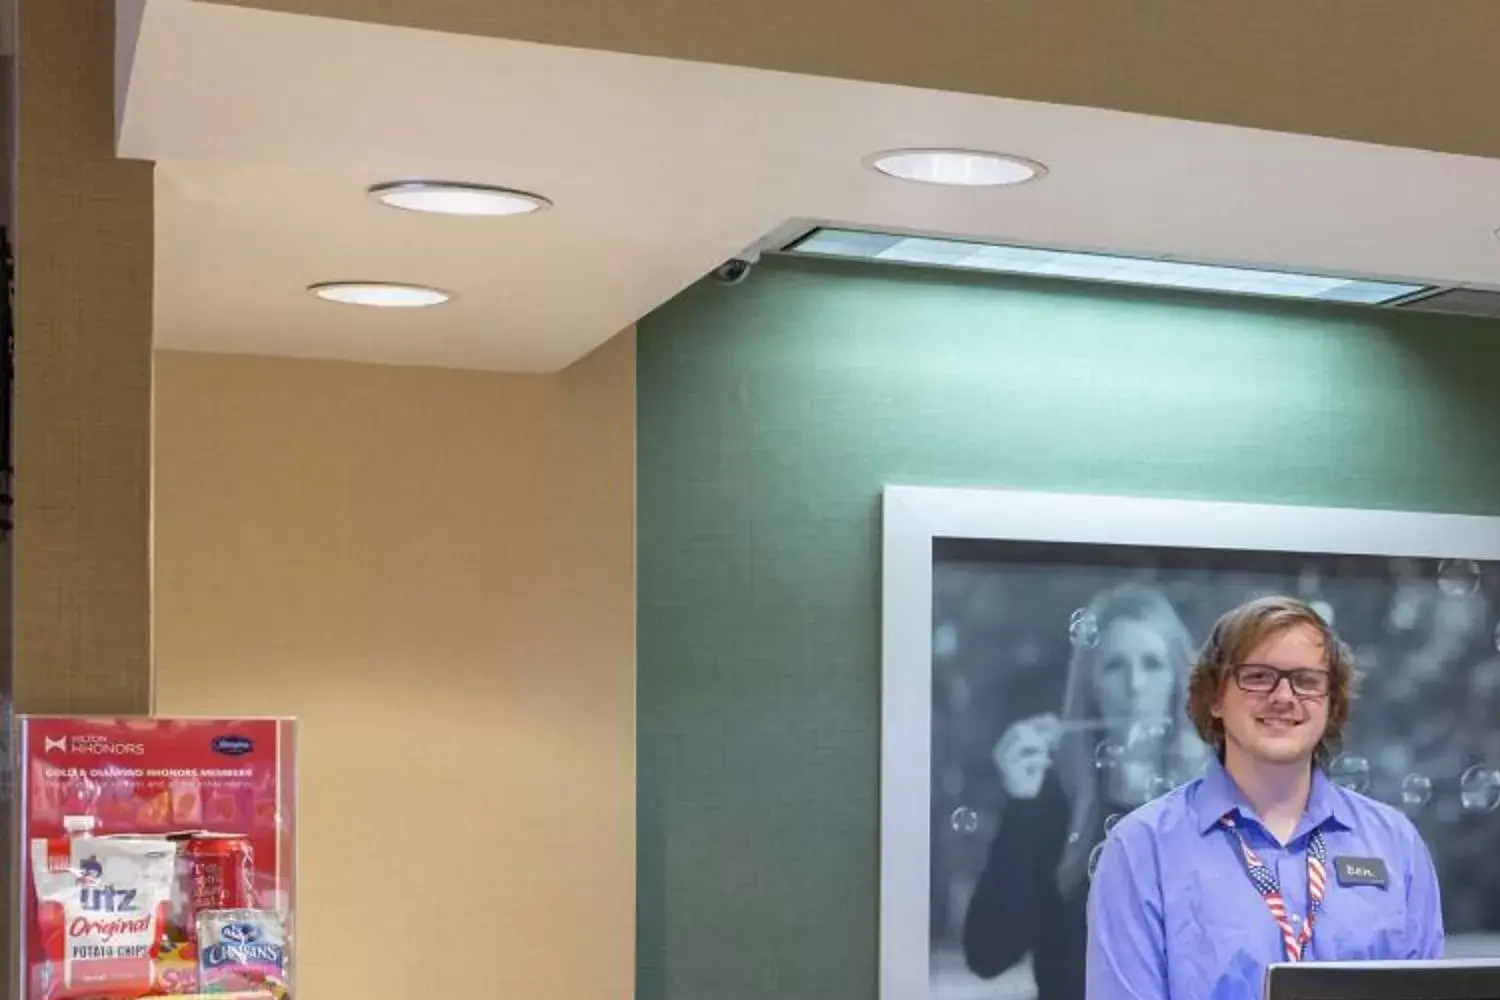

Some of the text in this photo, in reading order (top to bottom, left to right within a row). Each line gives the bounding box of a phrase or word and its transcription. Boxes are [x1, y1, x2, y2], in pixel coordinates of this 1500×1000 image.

[71, 743, 145, 755] HHONORS
[69, 912, 151, 943] Original
[72, 944, 113, 959] POTATO
